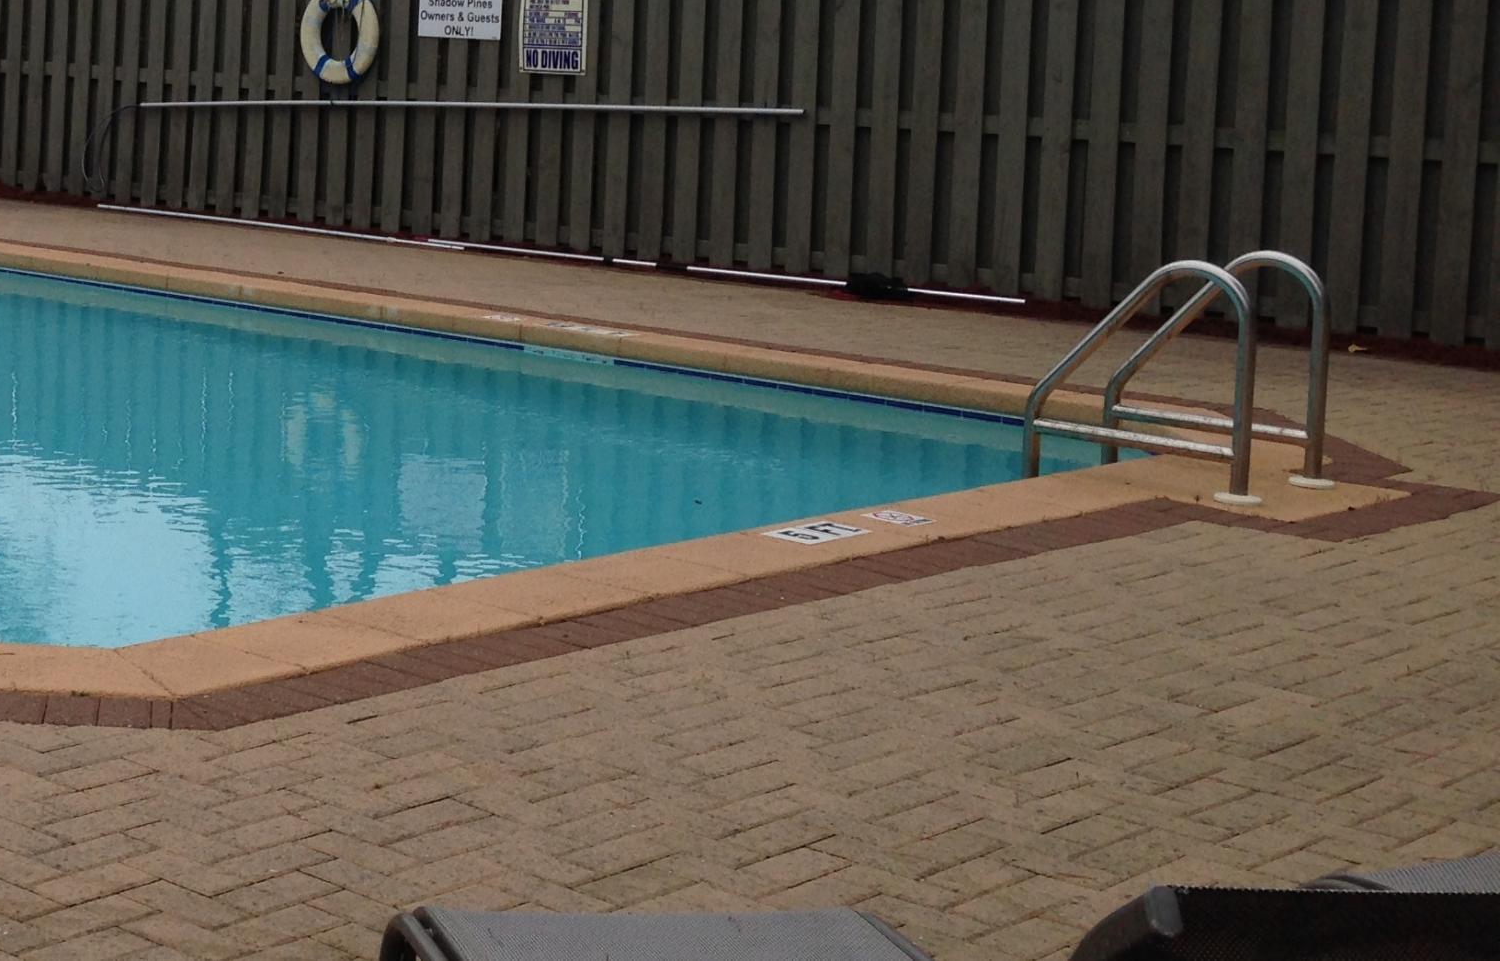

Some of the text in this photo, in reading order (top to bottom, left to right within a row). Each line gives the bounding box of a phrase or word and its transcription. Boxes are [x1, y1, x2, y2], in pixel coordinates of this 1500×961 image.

[420, 10, 500, 23] Owners & Guests
[444, 25, 474, 36] ONLY!
[526, 49, 579, 70] NO DIVING
[776, 523, 862, 540] 5 FT
